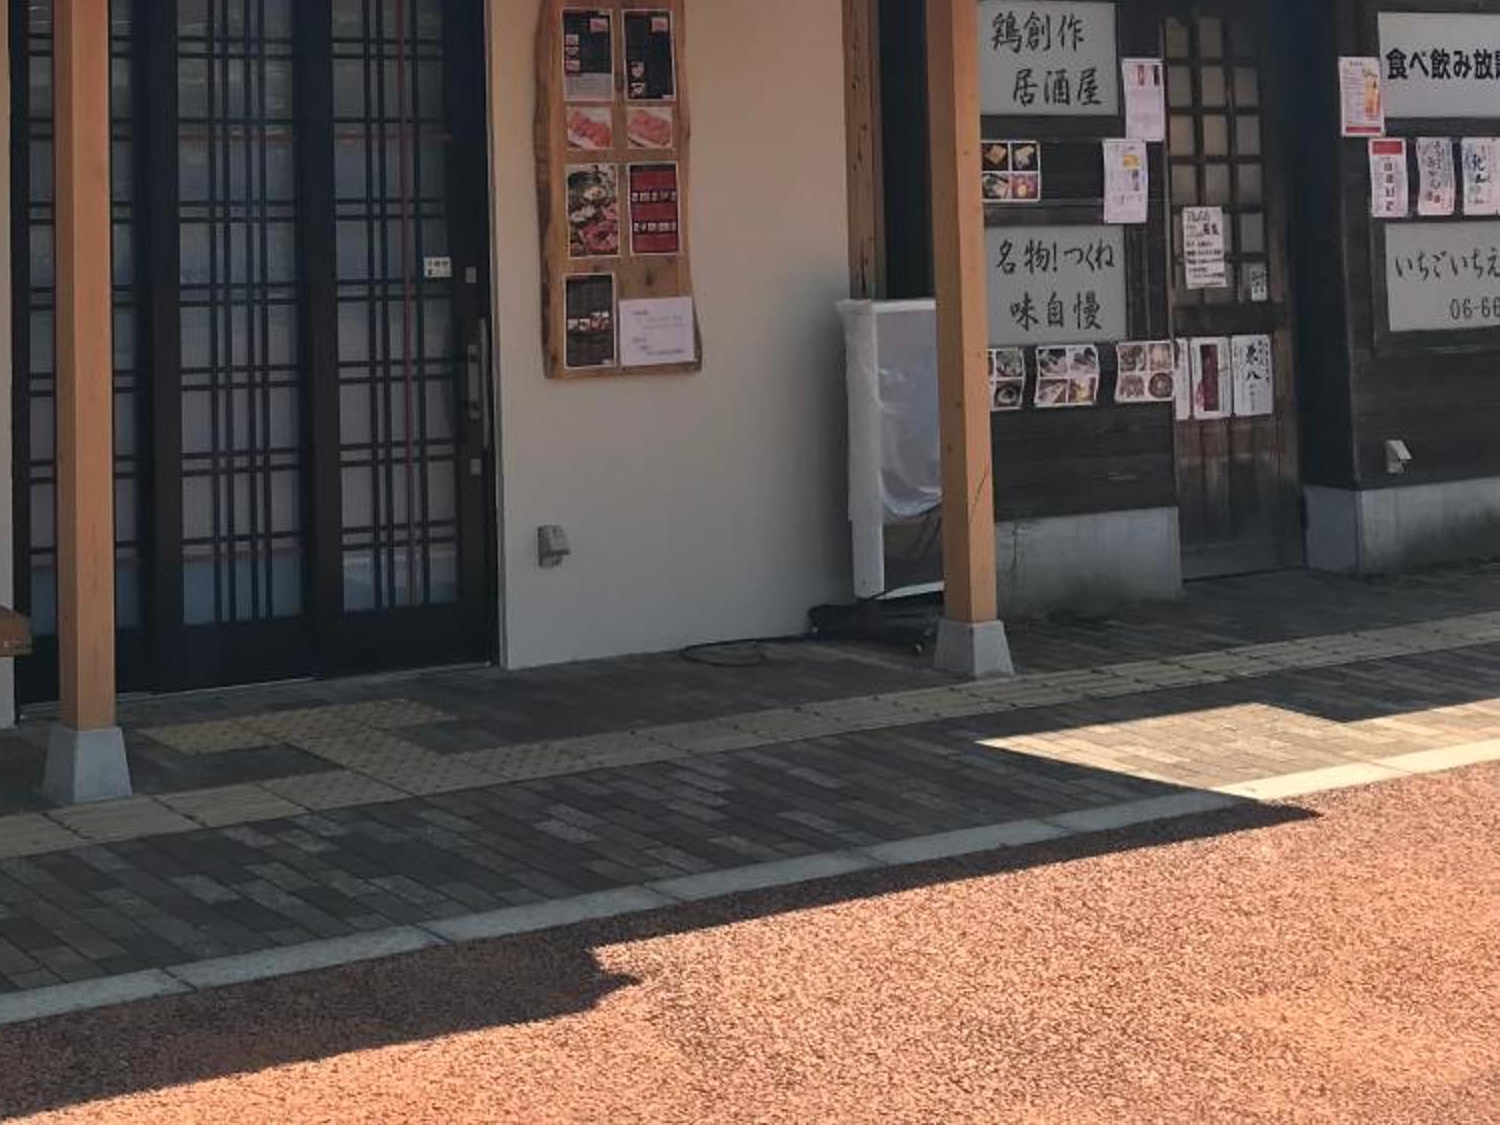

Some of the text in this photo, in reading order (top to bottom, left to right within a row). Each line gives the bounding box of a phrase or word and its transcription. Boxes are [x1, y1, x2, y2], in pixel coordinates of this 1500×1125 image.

[991, 9, 1086, 54] 鶏創作
[1011, 66, 1104, 108] 居酒屋
[1009, 289, 1103, 332] 味自慢
